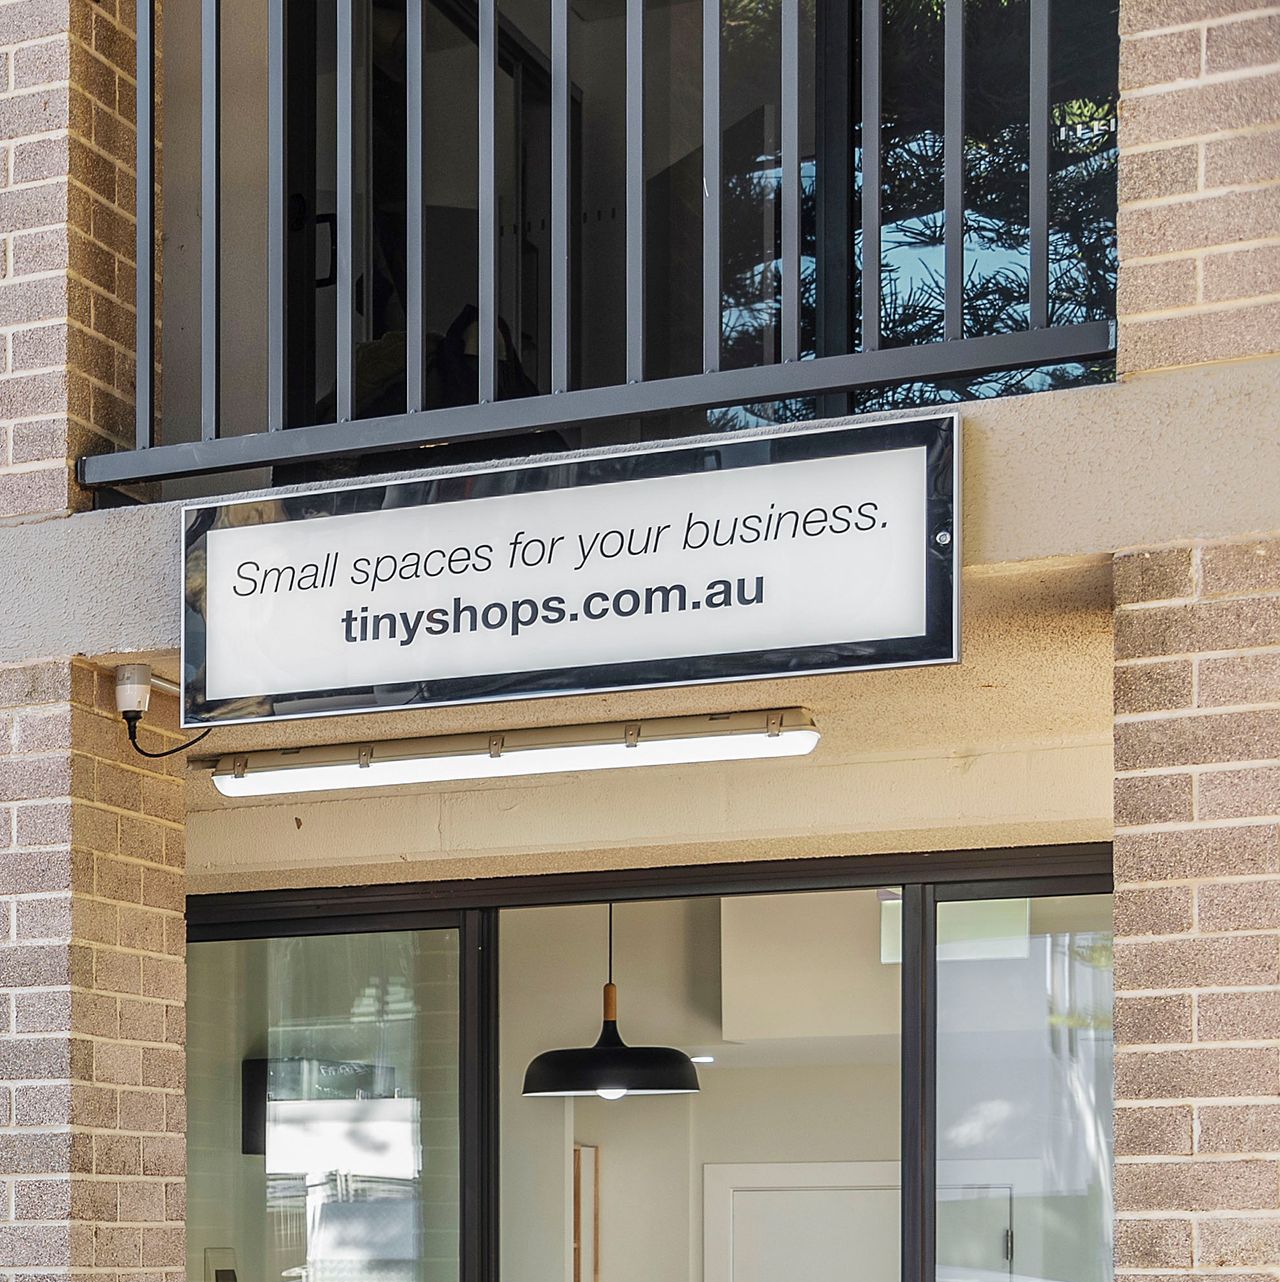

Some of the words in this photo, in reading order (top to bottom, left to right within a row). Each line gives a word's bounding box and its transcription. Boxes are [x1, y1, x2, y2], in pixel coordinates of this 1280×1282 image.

[232, 551, 339, 597] Small
[350, 543, 493, 592] spaces
[508, 531, 565, 569] for
[573, 523, 671, 571] your
[682, 501, 888, 550] business.
[340, 575, 765, 647] tinyshops.com.au
